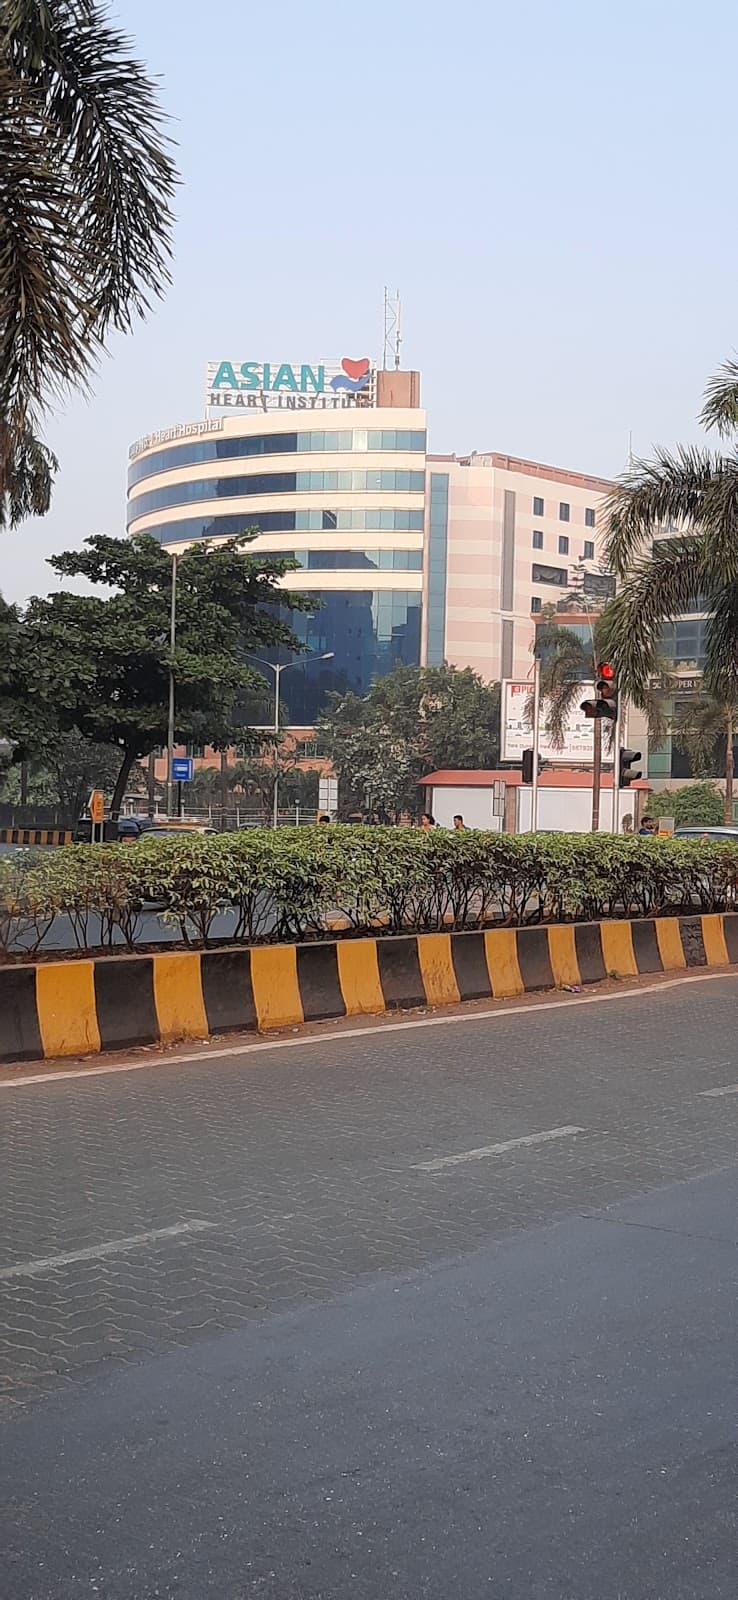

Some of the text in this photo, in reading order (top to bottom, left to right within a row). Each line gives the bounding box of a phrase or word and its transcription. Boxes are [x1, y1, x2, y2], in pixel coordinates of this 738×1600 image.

[212, 361, 325, 392] ASIAN
[210, 393, 268, 408] HEART
[180, 418, 222, 436] Hospital
